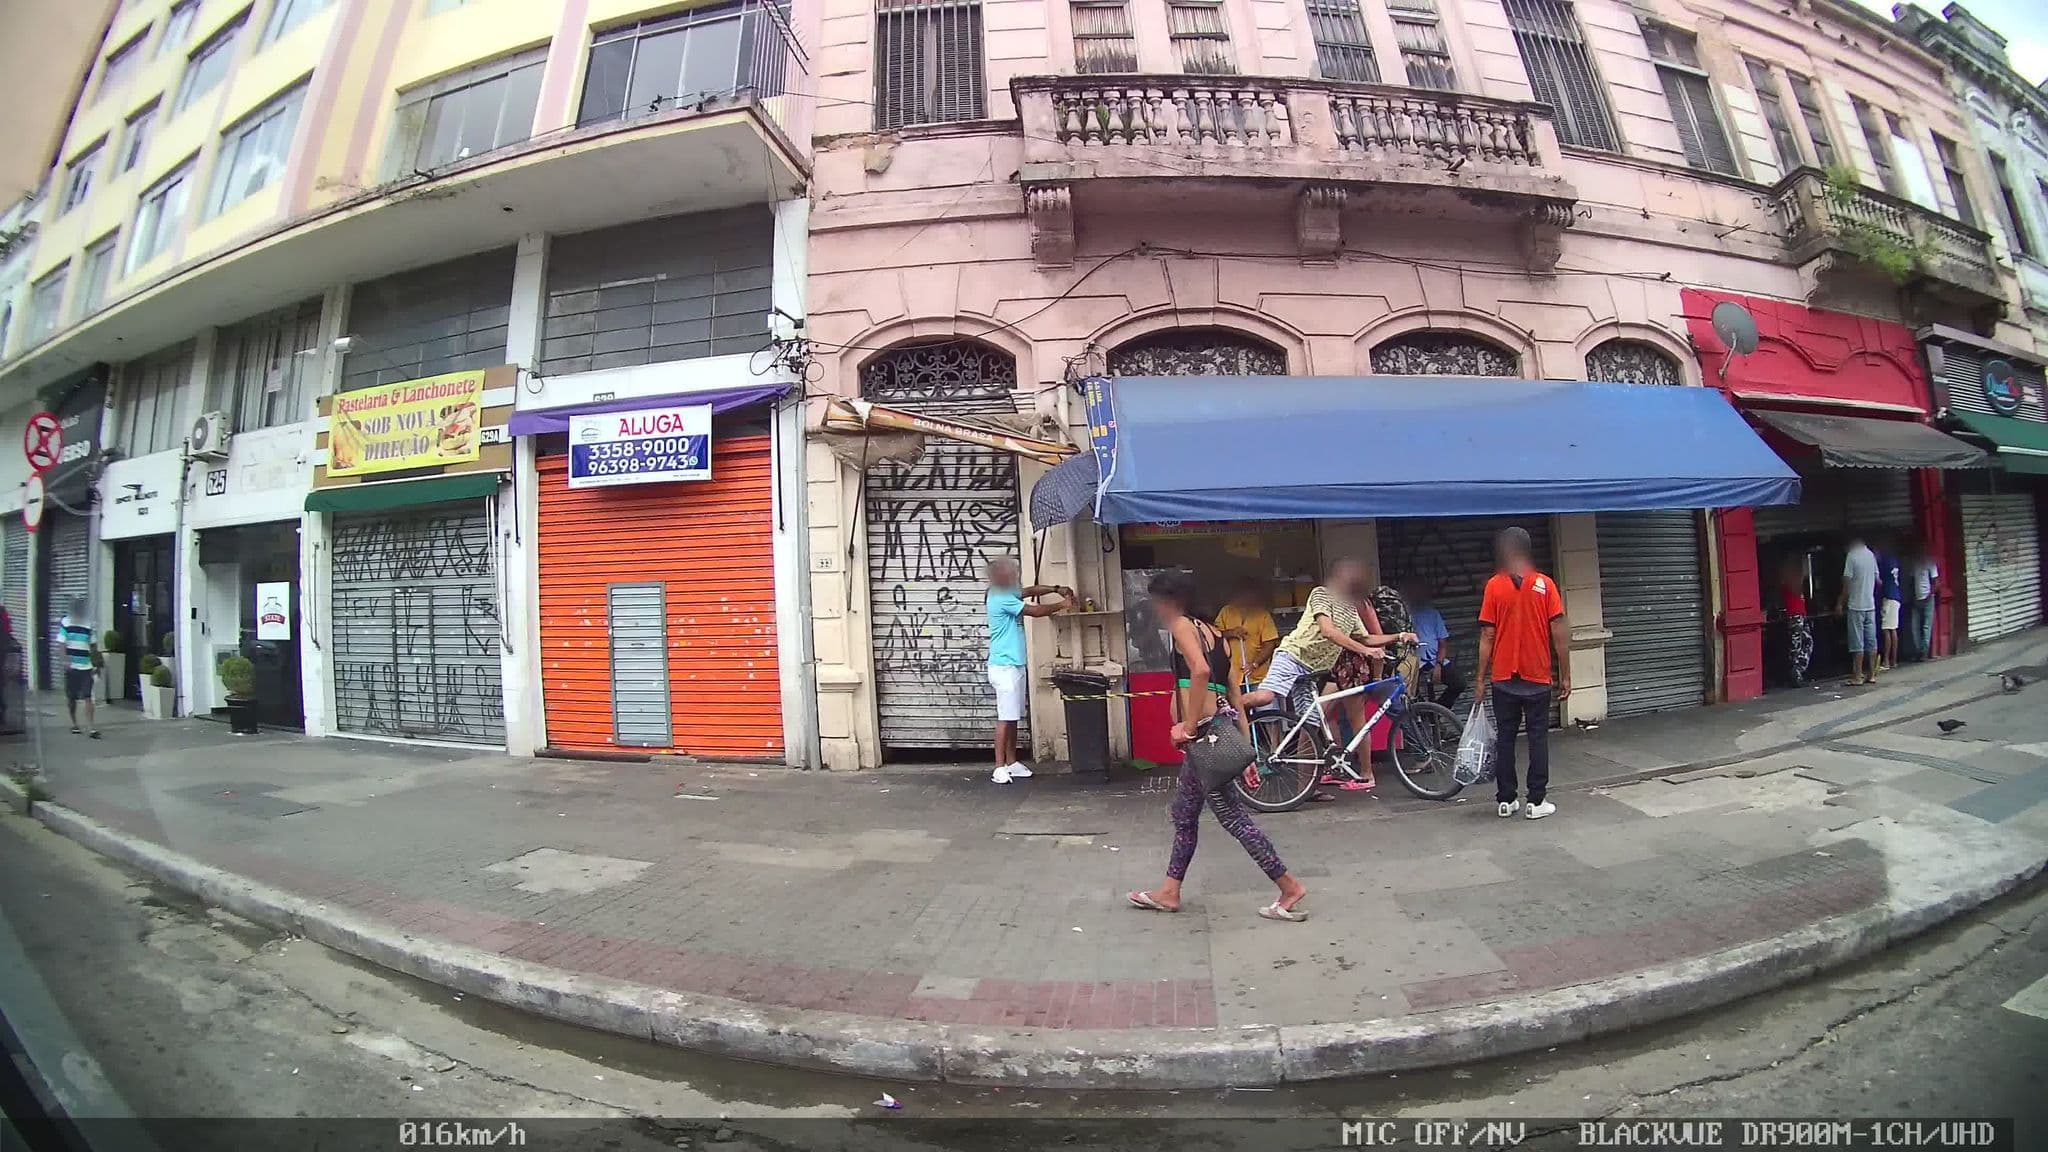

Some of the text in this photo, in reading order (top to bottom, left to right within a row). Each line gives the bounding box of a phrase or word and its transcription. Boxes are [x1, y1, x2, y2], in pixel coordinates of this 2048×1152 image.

[338, 378, 476, 413] Pastelaria & Lanchonete
[364, 409, 437, 435] SOB NOVA
[619, 414, 684, 437] ALUGA
[481, 430, 499, 443] 629A
[955, 428, 994, 443] BRASA
[364, 434, 430, 461] DIREÇÃO
[588, 438, 690, 460] 3358-9000
[588, 455, 689, 475] 96398-9743
[207, 471, 226, 494] 625
